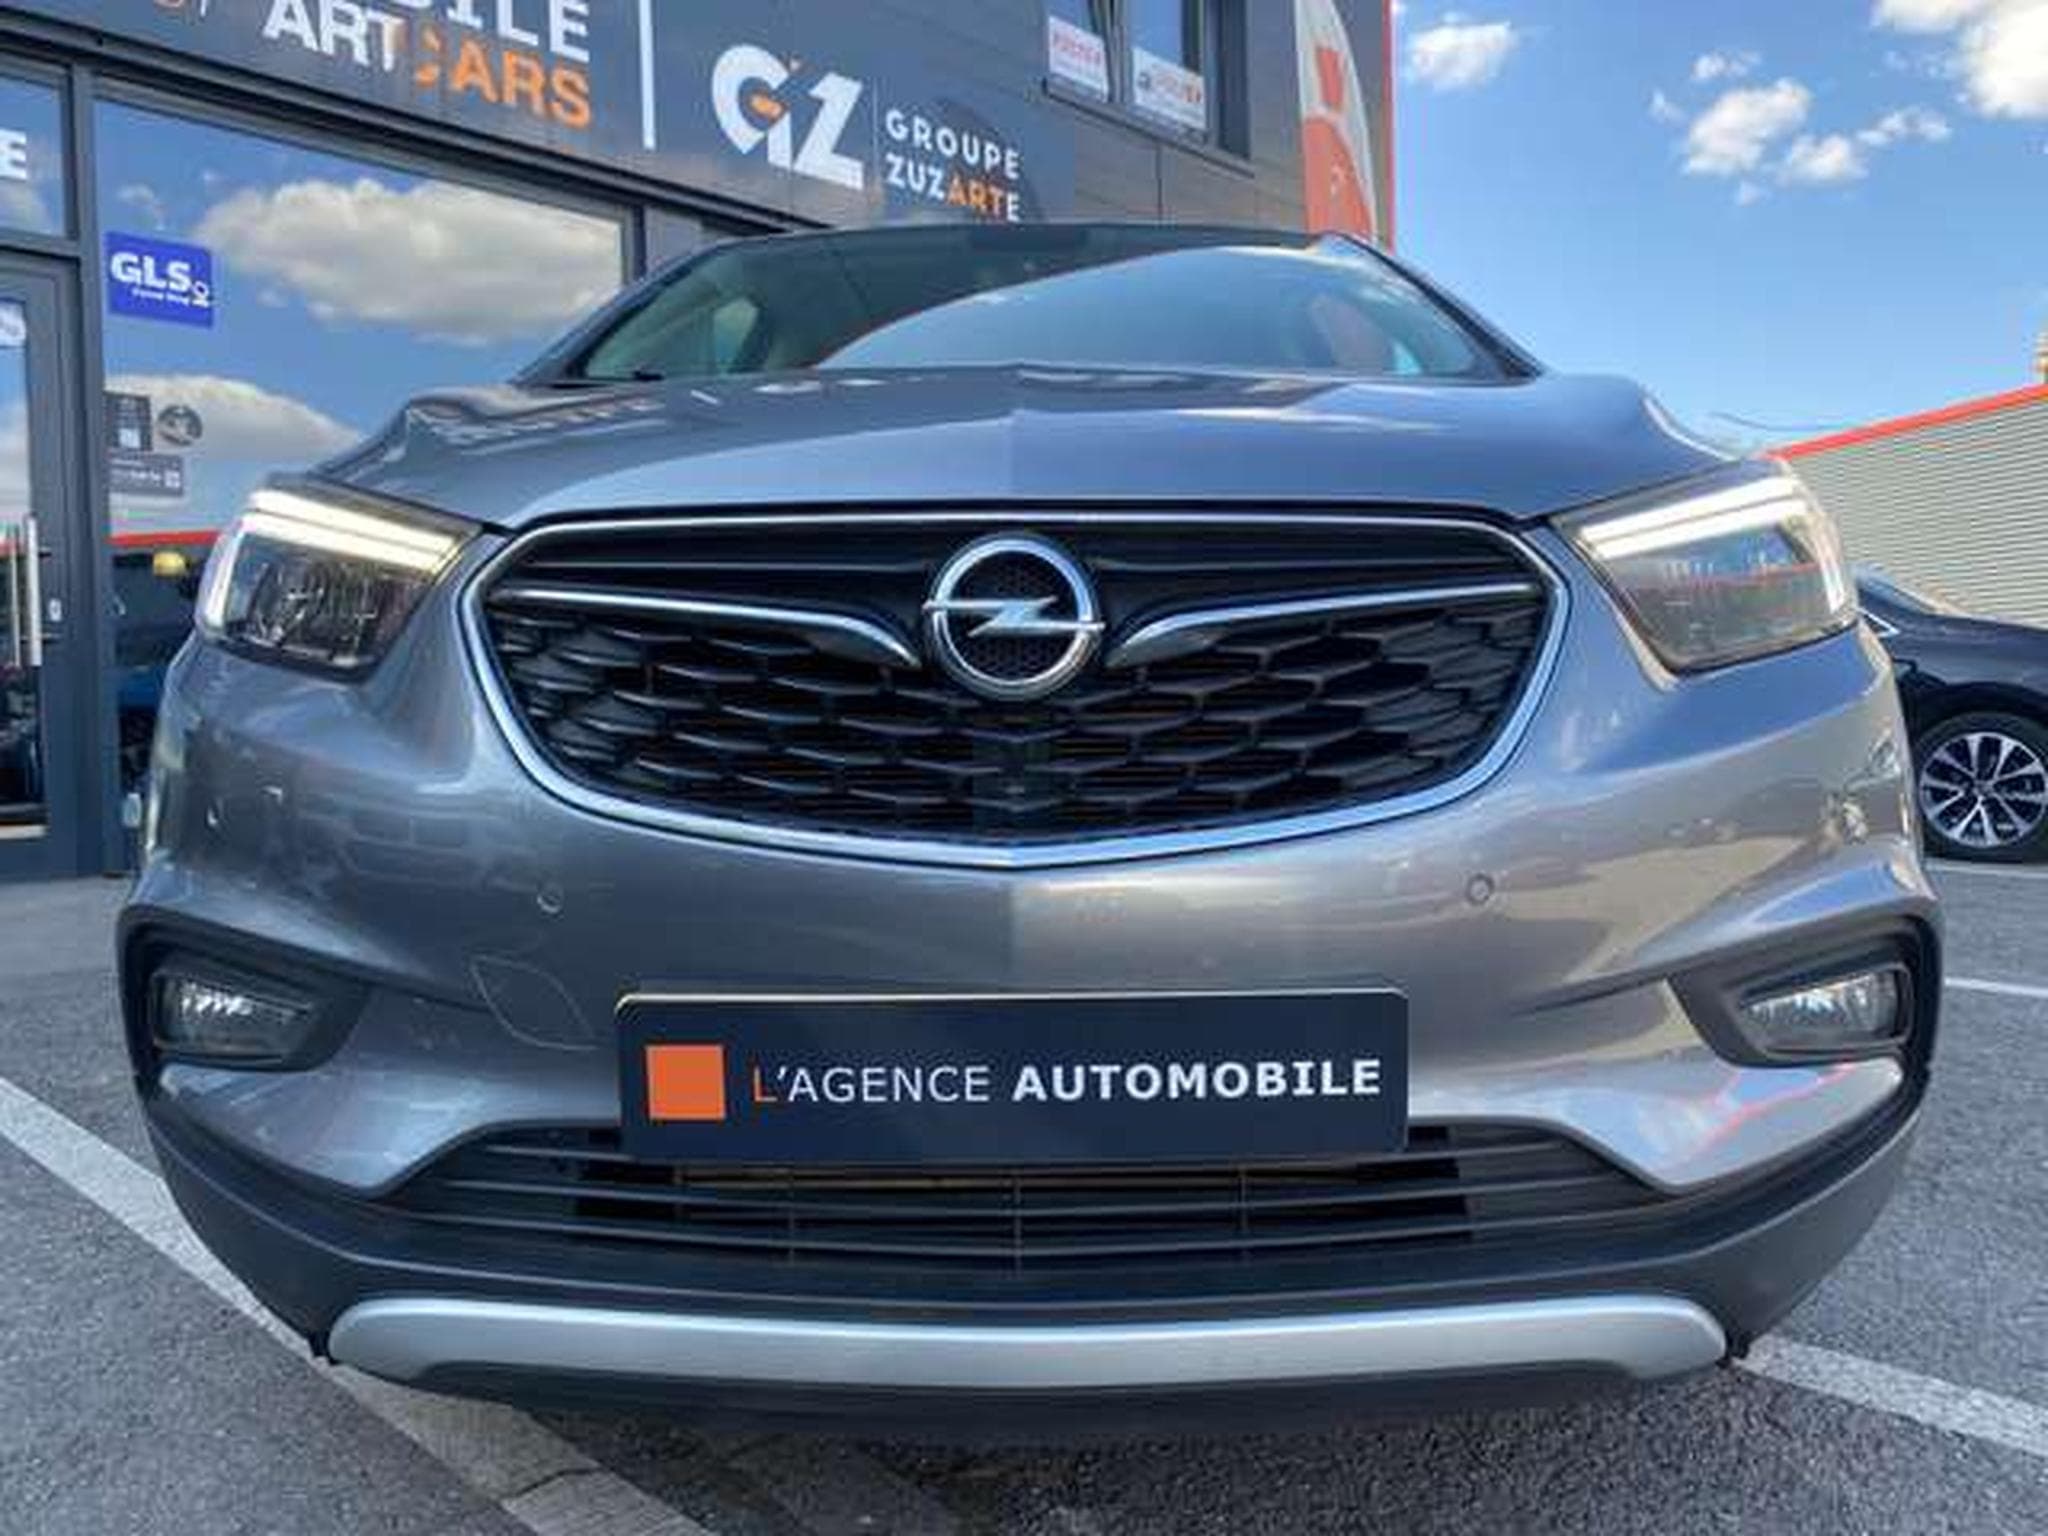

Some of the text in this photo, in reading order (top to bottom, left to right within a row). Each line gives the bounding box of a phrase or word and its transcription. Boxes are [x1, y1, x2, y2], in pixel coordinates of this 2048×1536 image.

[885, 109, 1020, 180] GROUPE
[885, 152, 1020, 222] ZUZARTE
[111, 251, 191, 292] GLS
[754, 1059, 1382, 1103] L'AGENCE AUTOMOBILE
